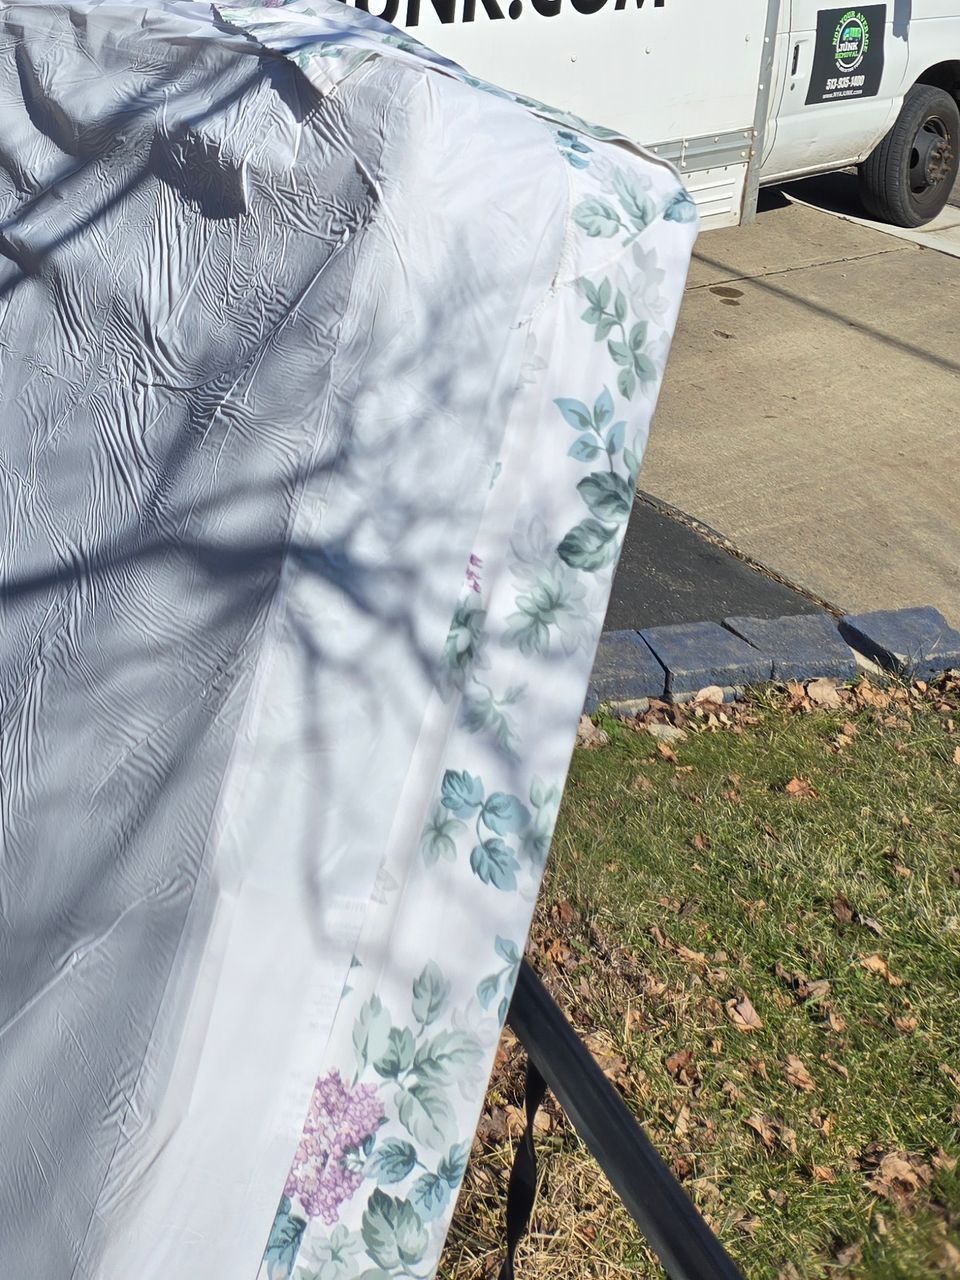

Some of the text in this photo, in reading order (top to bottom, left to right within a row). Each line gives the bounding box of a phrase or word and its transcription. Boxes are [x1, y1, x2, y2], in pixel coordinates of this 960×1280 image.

[832, 26, 841, 45] NOT
[840, 10, 855, 25] YOUR
[837, 41, 858, 52] JUNK
